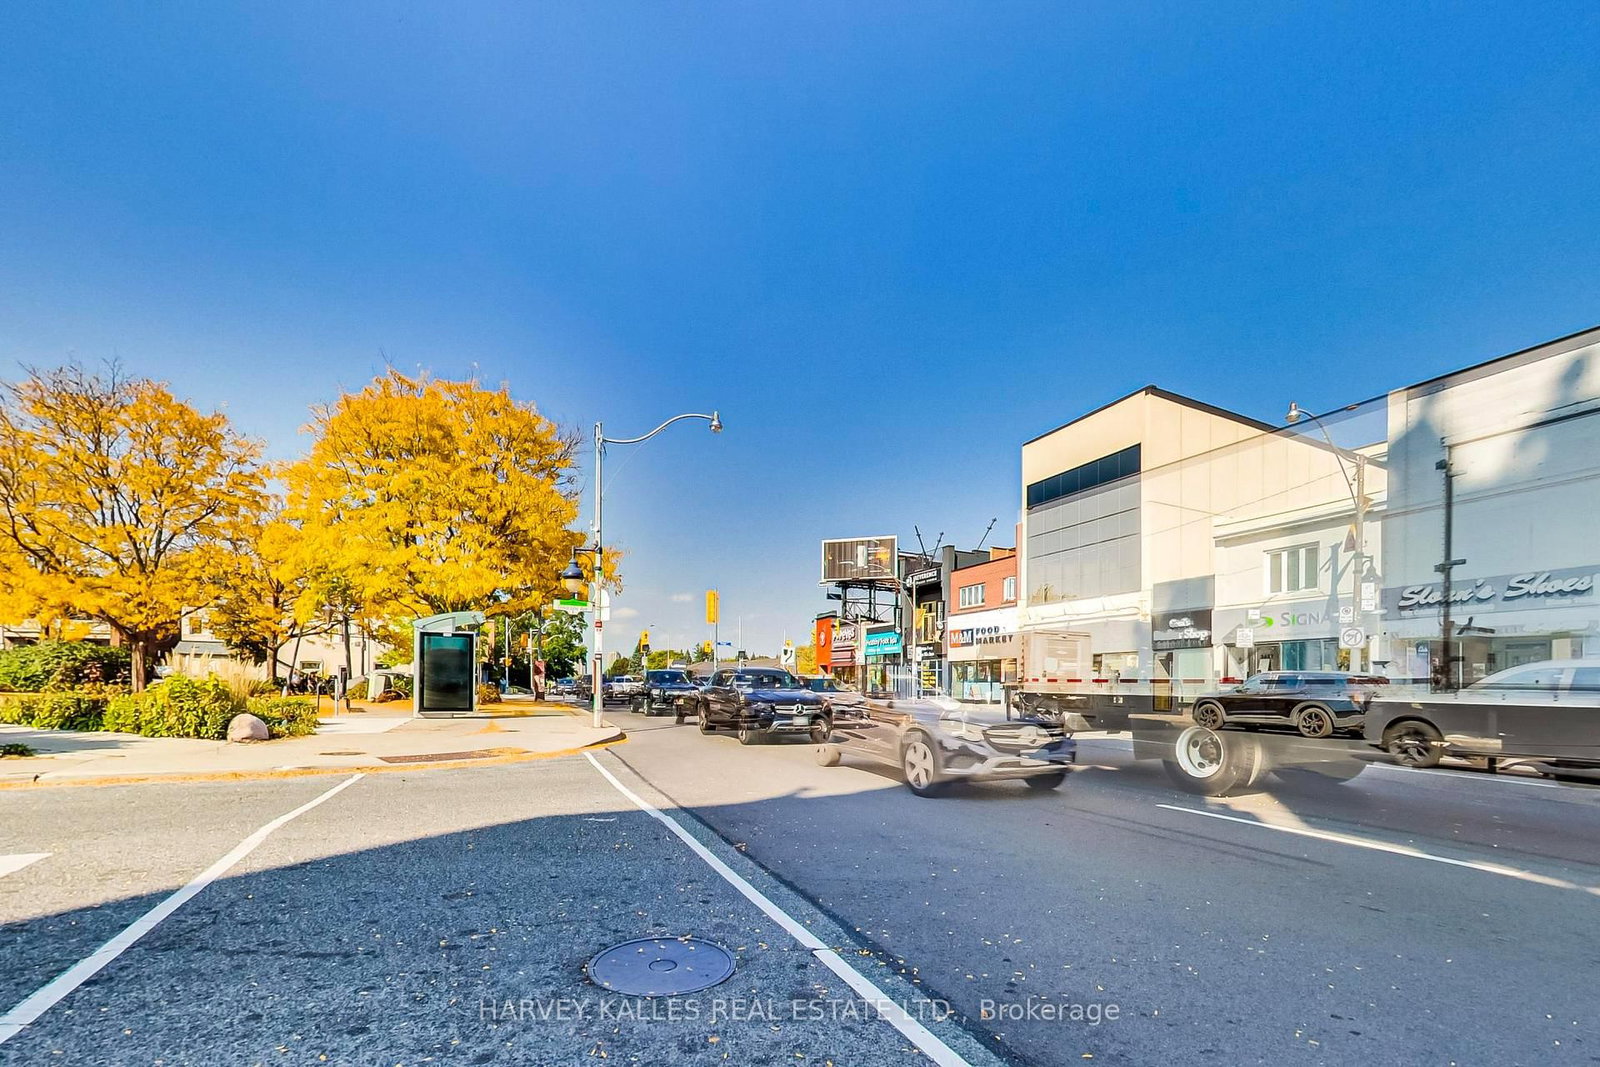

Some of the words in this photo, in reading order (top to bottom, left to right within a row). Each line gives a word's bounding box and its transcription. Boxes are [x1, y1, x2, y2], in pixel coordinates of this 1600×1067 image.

[1398, 579, 1495, 605] Slon's
[1504, 573, 1593, 597] Shoes
[976, 626, 1000, 635] FOOD
[951, 630, 973, 644] M&M
[976, 635, 1013, 645] MARKET
